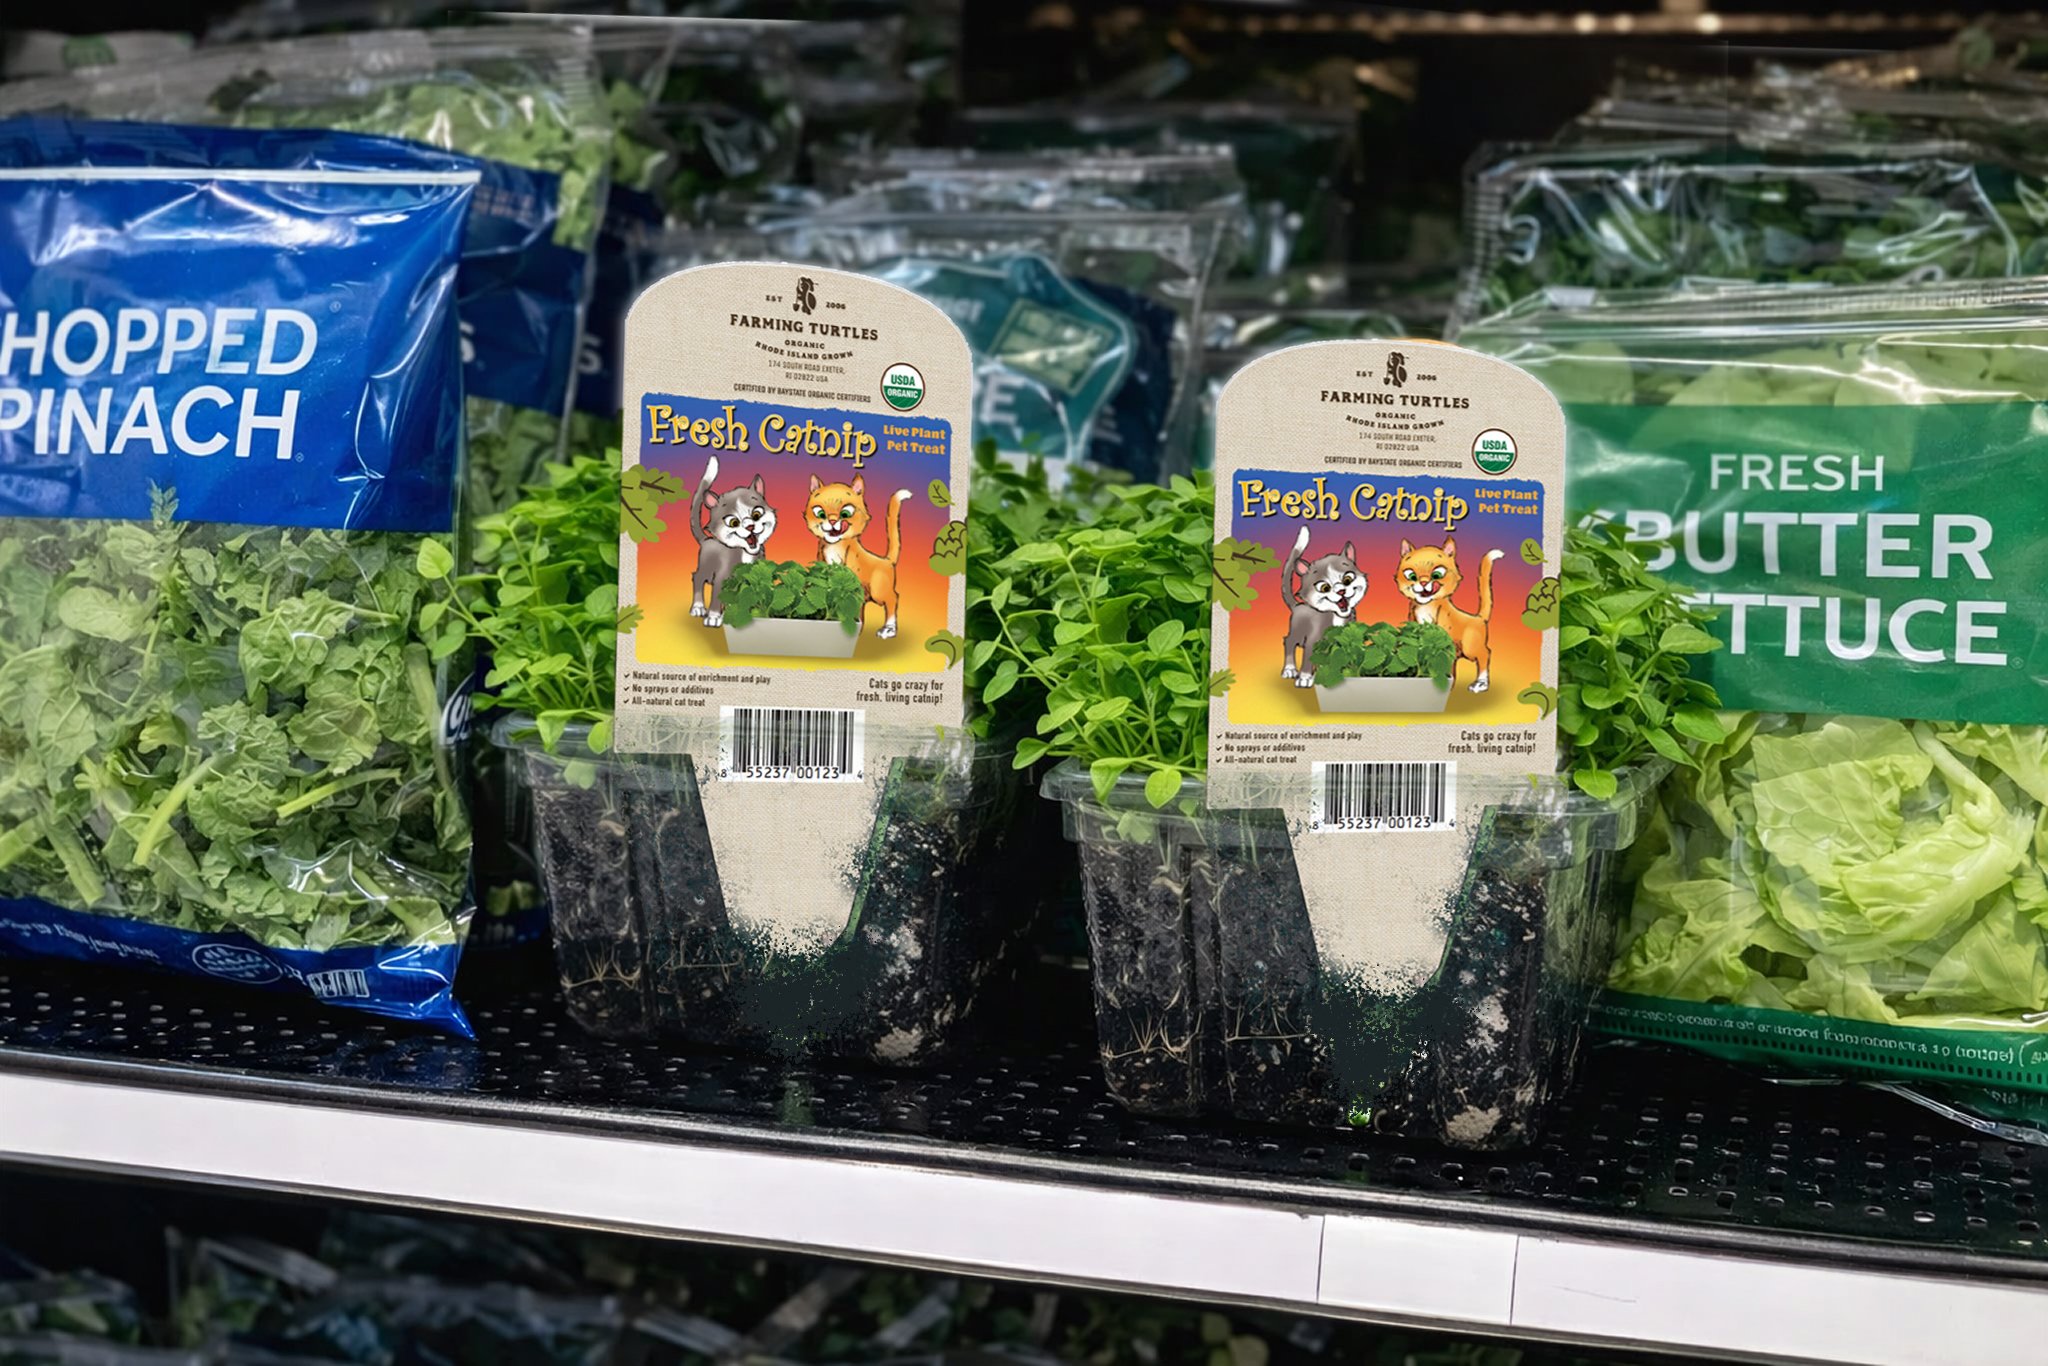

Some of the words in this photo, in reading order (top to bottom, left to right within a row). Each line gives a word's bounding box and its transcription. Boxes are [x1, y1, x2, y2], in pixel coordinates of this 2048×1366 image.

[826, 302, 846, 310] 2006
[730, 314, 804, 333] FARMING
[809, 322, 879, 341] TURTLES
[0, 308, 318, 377] HOPPED
[785, 339, 825, 350] ORGANIC
[755, 341, 784, 355] RHODE
[787, 351, 819, 360] ISLAND
[822, 351, 853, 360] GROWN
[768, 360, 781, 368] 174
[783, 361, 802, 370] SOUTH
[804, 363, 820, 372] ROAD
[816, 375, 828, 383] USA
[891, 374, 916, 386] USDA
[734, 383, 766, 394] CERTIFIED
[768, 385, 776, 394] BY
[778, 387, 806, 398] BAYSTATE
[808, 389, 835, 400] ORGANIC
[837, 392, 871, 403] CERTIFIERS
[887, 388, 918, 398] ORGANIC
[1321, 390, 1394, 405] FARMING
[1400, 395, 1470, 409] TURTLES
[1375, 412, 1416, 420] ORGANIC
[1346, 415, 1375, 428] RHODE
[1378, 423, 1409, 431] ISLAND
[1412, 420, 1444, 430] GROWN
[646, 403, 749, 452] Fresh
[758, 415, 878, 468] Catnip
[883, 425, 909, 436] Live
[911, 427, 946, 439] Plant
[1359, 432, 1371, 440] 174
[1374, 433, 1393, 441] SOUTH
[1395, 434, 1411, 442] ROAD
[887, 440, 908, 452] Pet
[910, 442, 945, 455] Treat
[1482, 440, 1507, 450] USDA
[1325, 456, 1357, 464] CERTIFIED
[1358, 457, 1367, 465] BY
[1368, 458, 1396, 466] BAYSTATE
[1399, 459, 1426, 468] ORGANIC
[1428, 460, 1462, 468] CERTIFIERS
[1479, 453, 1510, 462] ORGANIC
[1710, 453, 1884, 492] FRESH
[1475, 488, 1501, 498] Live
[1503, 490, 1538, 500] Plant
[1237, 477, 1340, 521] Fresh
[1350, 483, 1470, 531] Catnip
[1479, 503, 1499, 513] Pet
[1502, 504, 1538, 515] Treat
[1624, 510, 1993, 580] BUTTER
[1671, 592, 2007, 666] TTUCE
[632, 671, 659, 680] Natural
[662, 673, 686, 681] source
[688, 672, 696, 681] of
[698, 673, 739, 683] enrichment
[741, 675, 753, 683] and
[755, 675, 771, 685] play
[632, 684, 642, 692] No
[644, 686, 669, 695] sprays
[681, 685, 714, 694] additives
[869, 678, 888, 689] Cats
[891, 681, 902, 691] go
[905, 681, 928, 692] crazy
[931, 680, 944, 690] for
[631, 697, 672, 706] All-natural
[674, 698, 686, 706] cat
[688, 698, 705, 707] treat
[885, 691, 910, 705] living
[913, 693, 943, 706] catnip!
[1225, 731, 1251, 740] Natural
[1280, 731, 1288, 740] of
[1290, 731, 1330, 740] enrichment
[1332, 732, 1345, 740] and
[1347, 732, 1362, 741] play
[1461, 730, 1480, 740] Cats
[1483, 732, 1494, 743] go
[1497, 732, 1521, 742] crazy
[1524, 730, 1537, 740] for
[1224, 743, 1234, 751] No
[1236, 745, 1260, 753] sprays
[1273, 743, 1305, 751] additives
[1477, 743, 1502, 755] living
[1505, 743, 1536, 755] catnip!
[1224, 755, 1264, 764] All-natural
[1266, 756, 1278, 764] cat
[1280, 756, 1297, 764] treat
[747, 766, 789, 779] 55237
[797, 767, 839, 779] 00123
[1338, 818, 1381, 829] 55237
[1389, 817, 1431, 829] 00123
